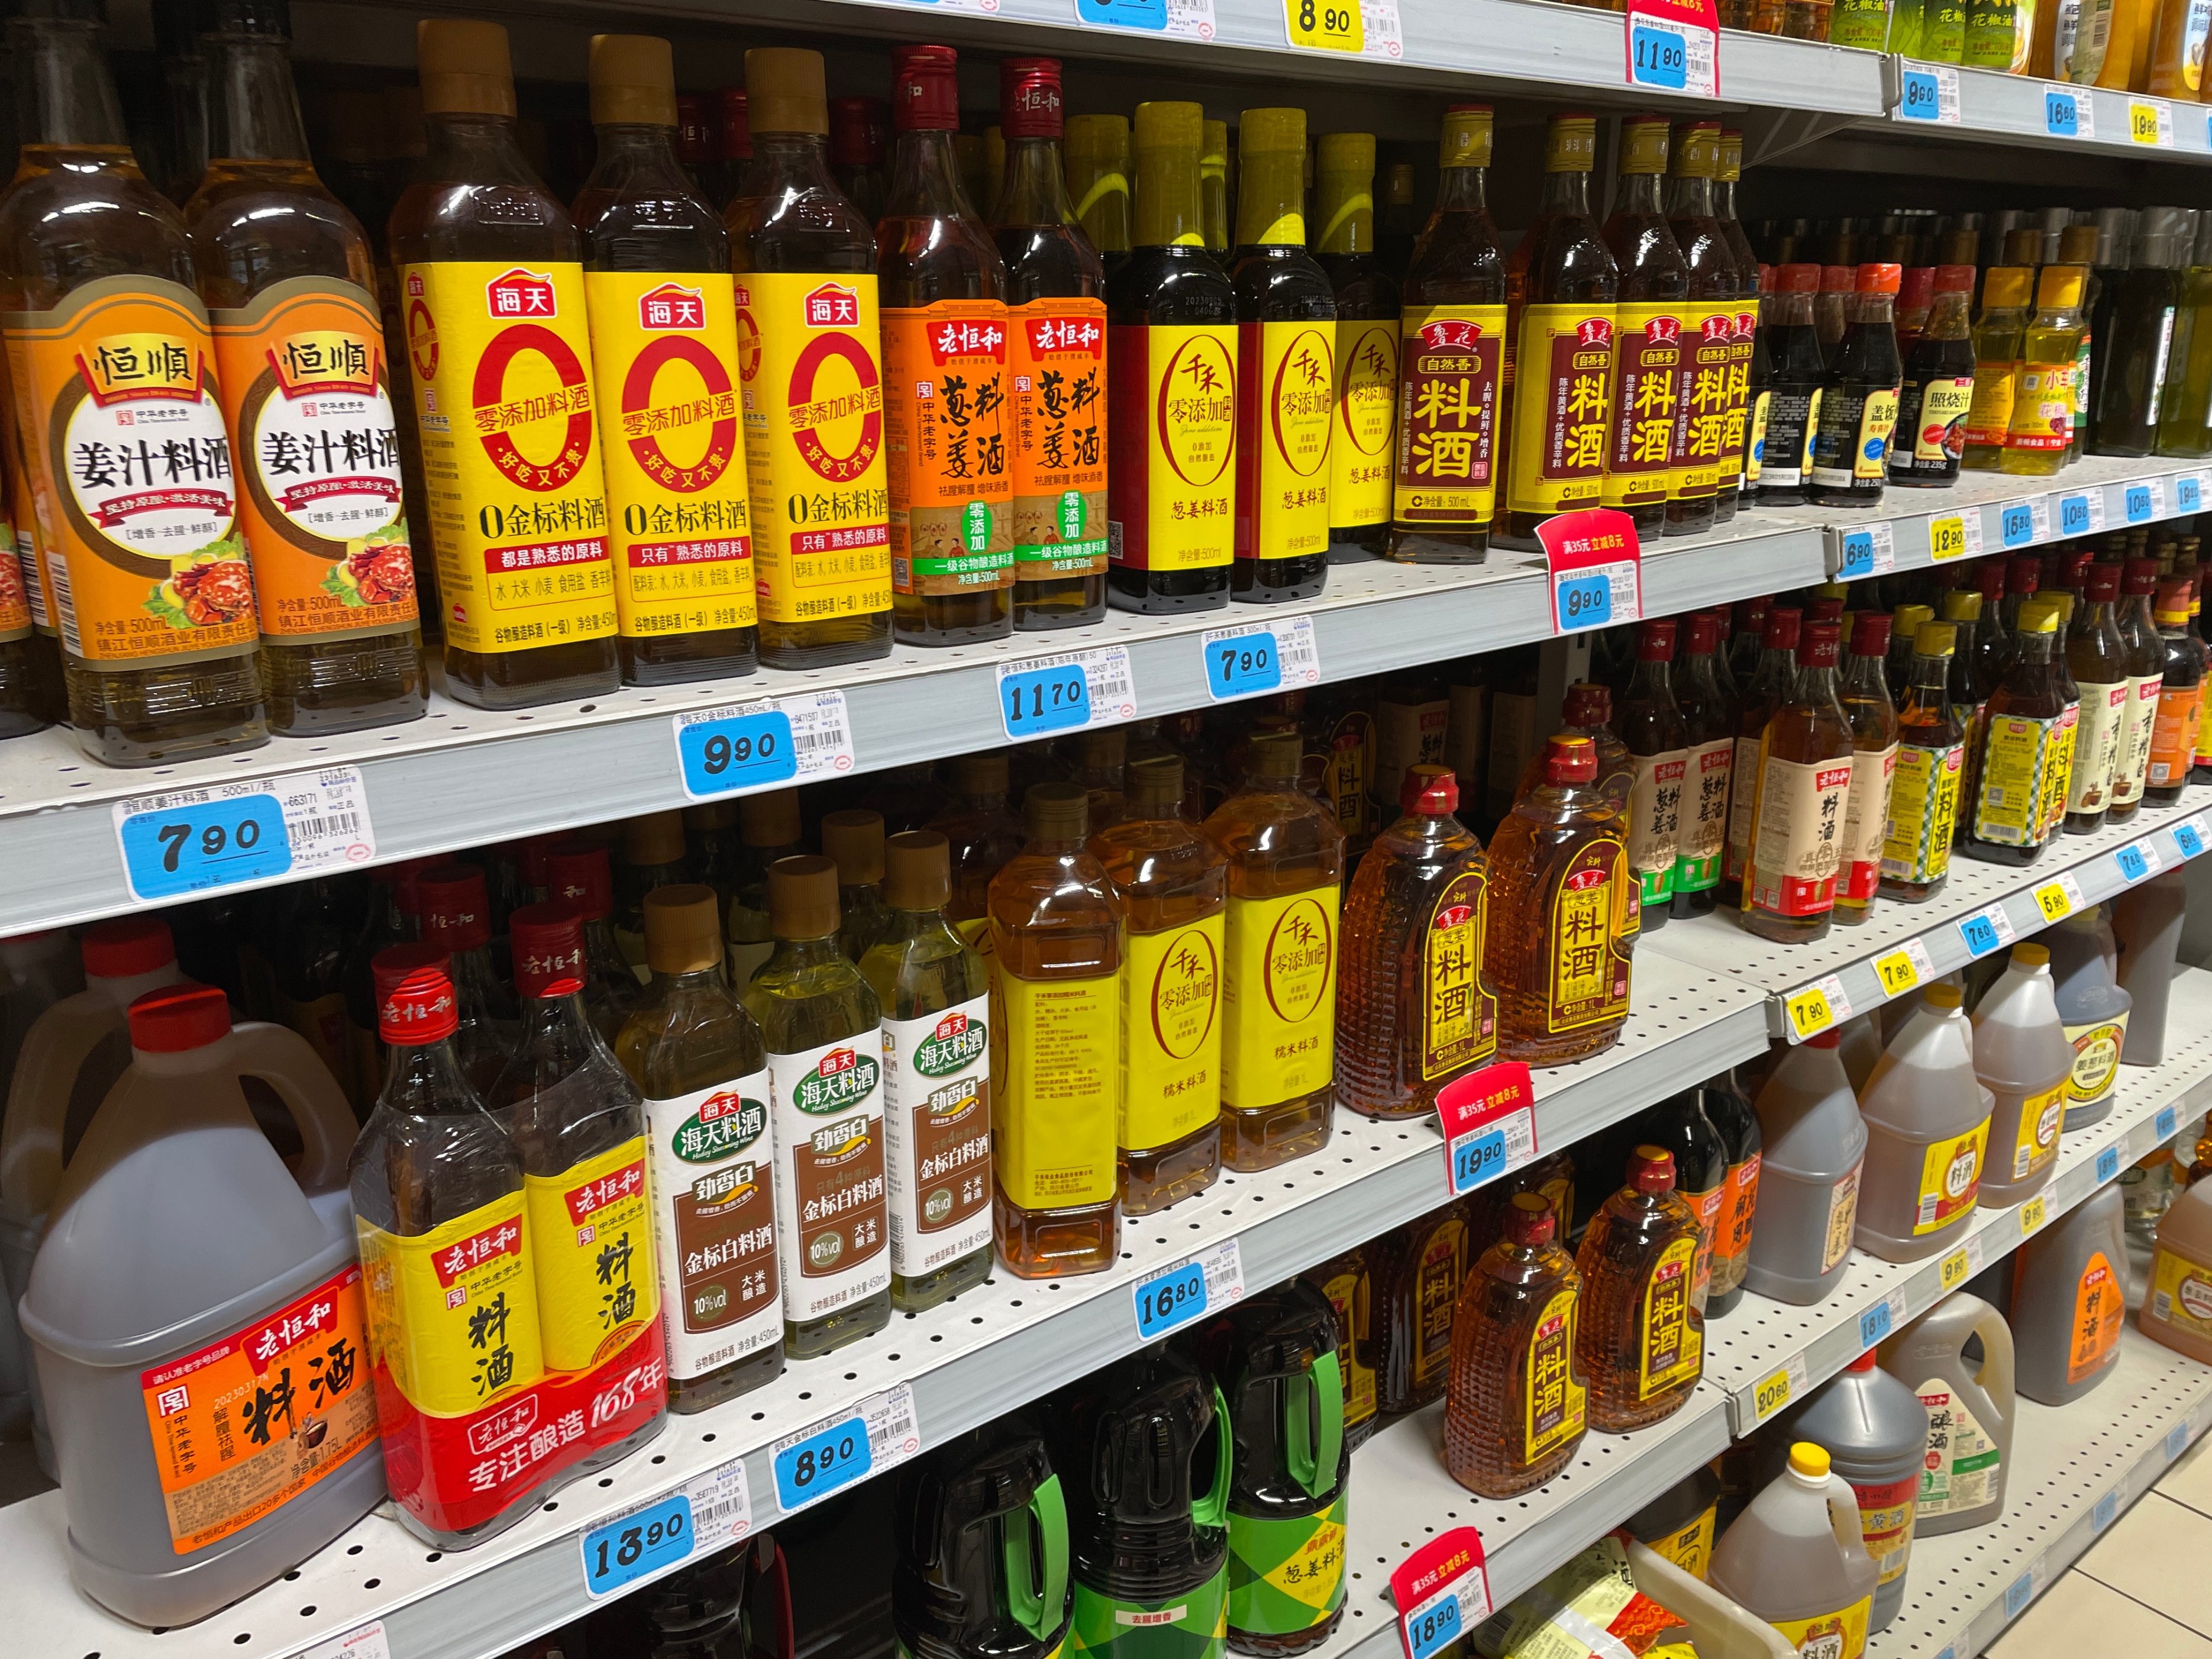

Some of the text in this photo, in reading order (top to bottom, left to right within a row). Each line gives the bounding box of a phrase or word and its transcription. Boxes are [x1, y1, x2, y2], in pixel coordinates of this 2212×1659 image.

[496, 288, 549, 312] 海天
[648, 301, 697, 325] 海天
[812, 299, 854, 322] 海天
[1291, 348, 1326, 388] 千禾
[1427, 357, 1472, 372] 自然香
[1579, 355, 1607, 367] 自然香
[1646, 352, 1674, 364] 自然香
[1702, 349, 1726, 361] 自然香
[1180, 354, 1224, 395] 千禾
[474, 385, 590, 432] 零添加料酒
[623, 393, 735, 436] 零添加料酒
[789, 386, 881, 429] 零添加料酒
[1168, 397, 1223, 425] 零添加
[1281, 390, 1325, 417] 零添加
[1688, 366, 1727, 457] 料酒
[1929, 392, 1970, 408] 照烧汁
[923, 401, 937, 460] 中华老字号
[1020, 395, 1034, 451] 中华老字号
[1412, 377, 1483, 478] 料酒
[73, 434, 232, 489] 姜汁料酒
[263, 428, 399, 475] 姜汁料酒
[498, 448, 583, 486] 好吃又不贵
[806, 443, 874, 478] 好吃又不贵
[644, 453, 726, 488] 好吃又不贵
[1349, 465, 1390, 485] 葱姜料酒
[1064, 492, 1079, 538] 零添加
[1171, 498, 1228, 520] 葱姜料酒
[1281, 487, 1327, 509] 葱姜料酒
[479, 498, 606, 539] 0金标料酒
[625, 498, 747, 536] 0金标料酒
[969, 503, 986, 551] 零添加
[501, 541, 603, 569] 都是熟悉的原料
[935, 551, 1015, 573] 一级谷物酿造料酒
[1029, 541, 1107, 559] 一级谷物酿造料酒
[1818, 770, 1849, 787] 老恒和
[1818, 792, 1839, 841] 料酒
[1283, 915, 1319, 947] 千禾
[1170, 948, 1206, 980] 千禾
[1272, 948, 1318, 975] 零添加
[939, 1018, 964, 1038] 海天
[822, 1053, 854, 1074] 海天
[920, 1026, 983, 1071] 海天料酒
[1274, 1035, 1319, 1061] 糯米料酒
[800, 1062, 874, 1108] 海天料酒
[930, 1080, 976, 1112] 劲香白
[1162, 1069, 1207, 1099] 糯米料酒
[1458, 1085, 1520, 1121] 满35元 立减8元
[681, 1106, 761, 1156] 海天料酒
[814, 1116, 868, 1152] 劲香白
[919, 1133, 989, 1181] 金标白料酒
[576, 1169, 641, 1213] 老恒和
[696, 1164, 755, 1202] 劲香白
[802, 1174, 883, 1223] 金标白料酒
[963, 1176, 983, 1192] 大米
[963, 1187, 983, 1204] 酿造
[599, 1202, 644, 1230] 中华老字号
[855, 1218, 876, 1235] 大米
[444, 1227, 518, 1275] 老恒和
[685, 1224, 773, 1276] 金标白料酒
[855, 1231, 877, 1247] 酿造
[741, 1270, 766, 1289] 大米
[741, 1282, 767, 1302] 酿造
[256, 1302, 331, 1361] 老恒和
[1649, 1291, 1683, 1357] 料酒
[152, 1344, 231, 1386] 请认准老字号品牌
[173, 1416, 197, 1474] 中华老字号
[469, 1409, 586, 1492] 专注酿造
[591, 1363, 664, 1428] 168年
[1411, 1550, 1470, 1596] 满35元 立减8元
